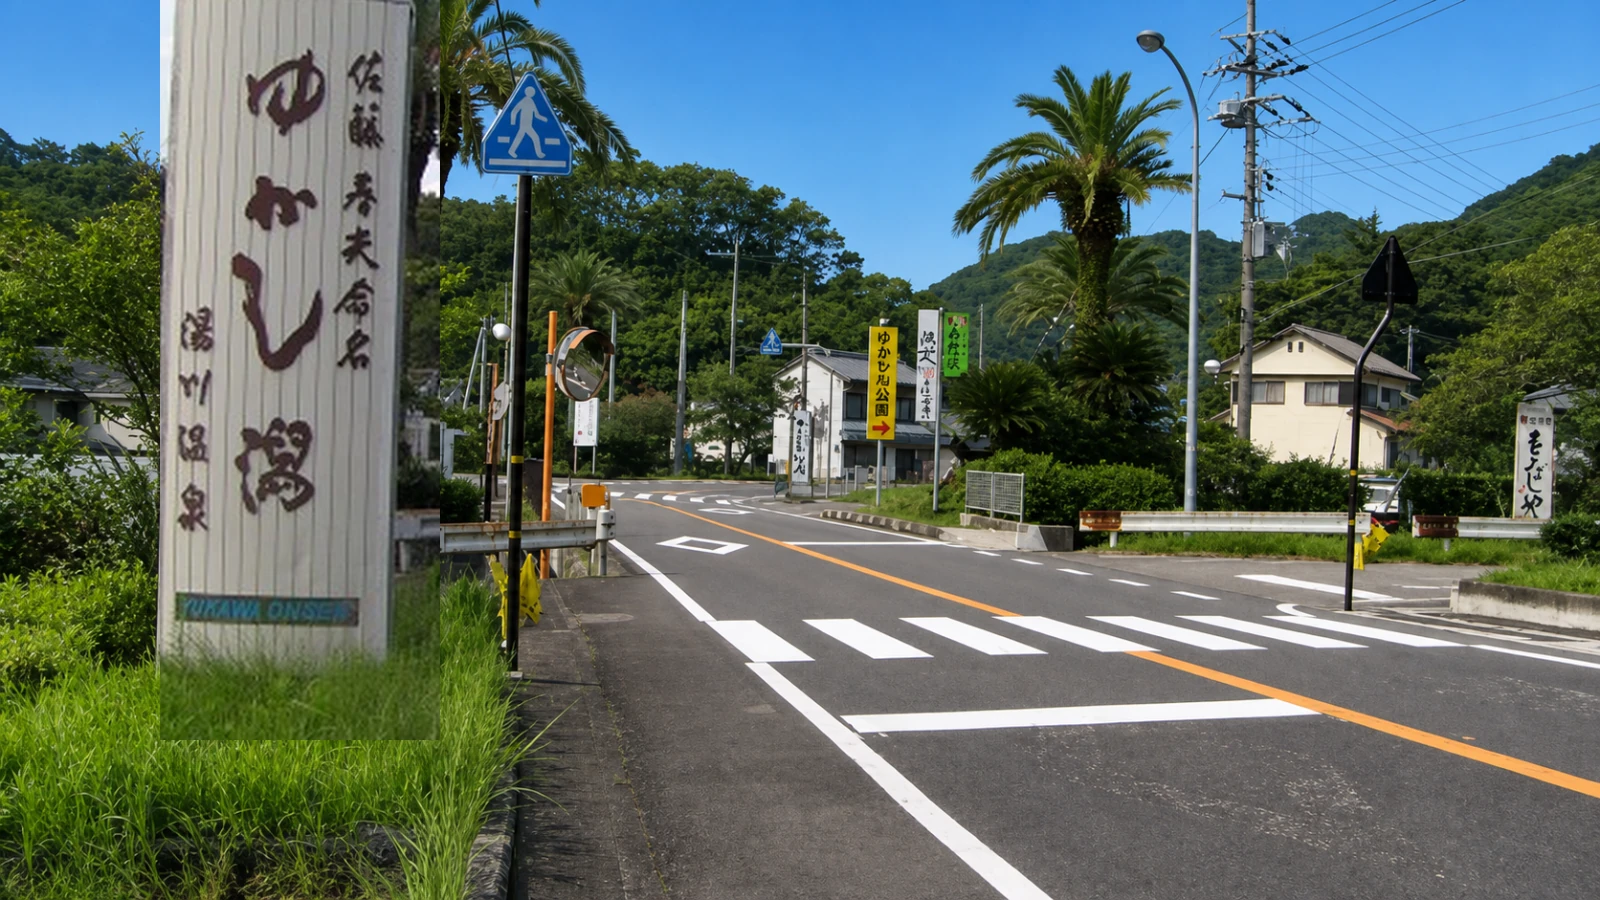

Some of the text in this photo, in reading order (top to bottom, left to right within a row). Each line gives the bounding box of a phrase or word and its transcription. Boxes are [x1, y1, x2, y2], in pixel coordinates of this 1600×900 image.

[178, 306, 214, 532] 湯川温泉
[232, 48, 325, 515] ゆかし潟
